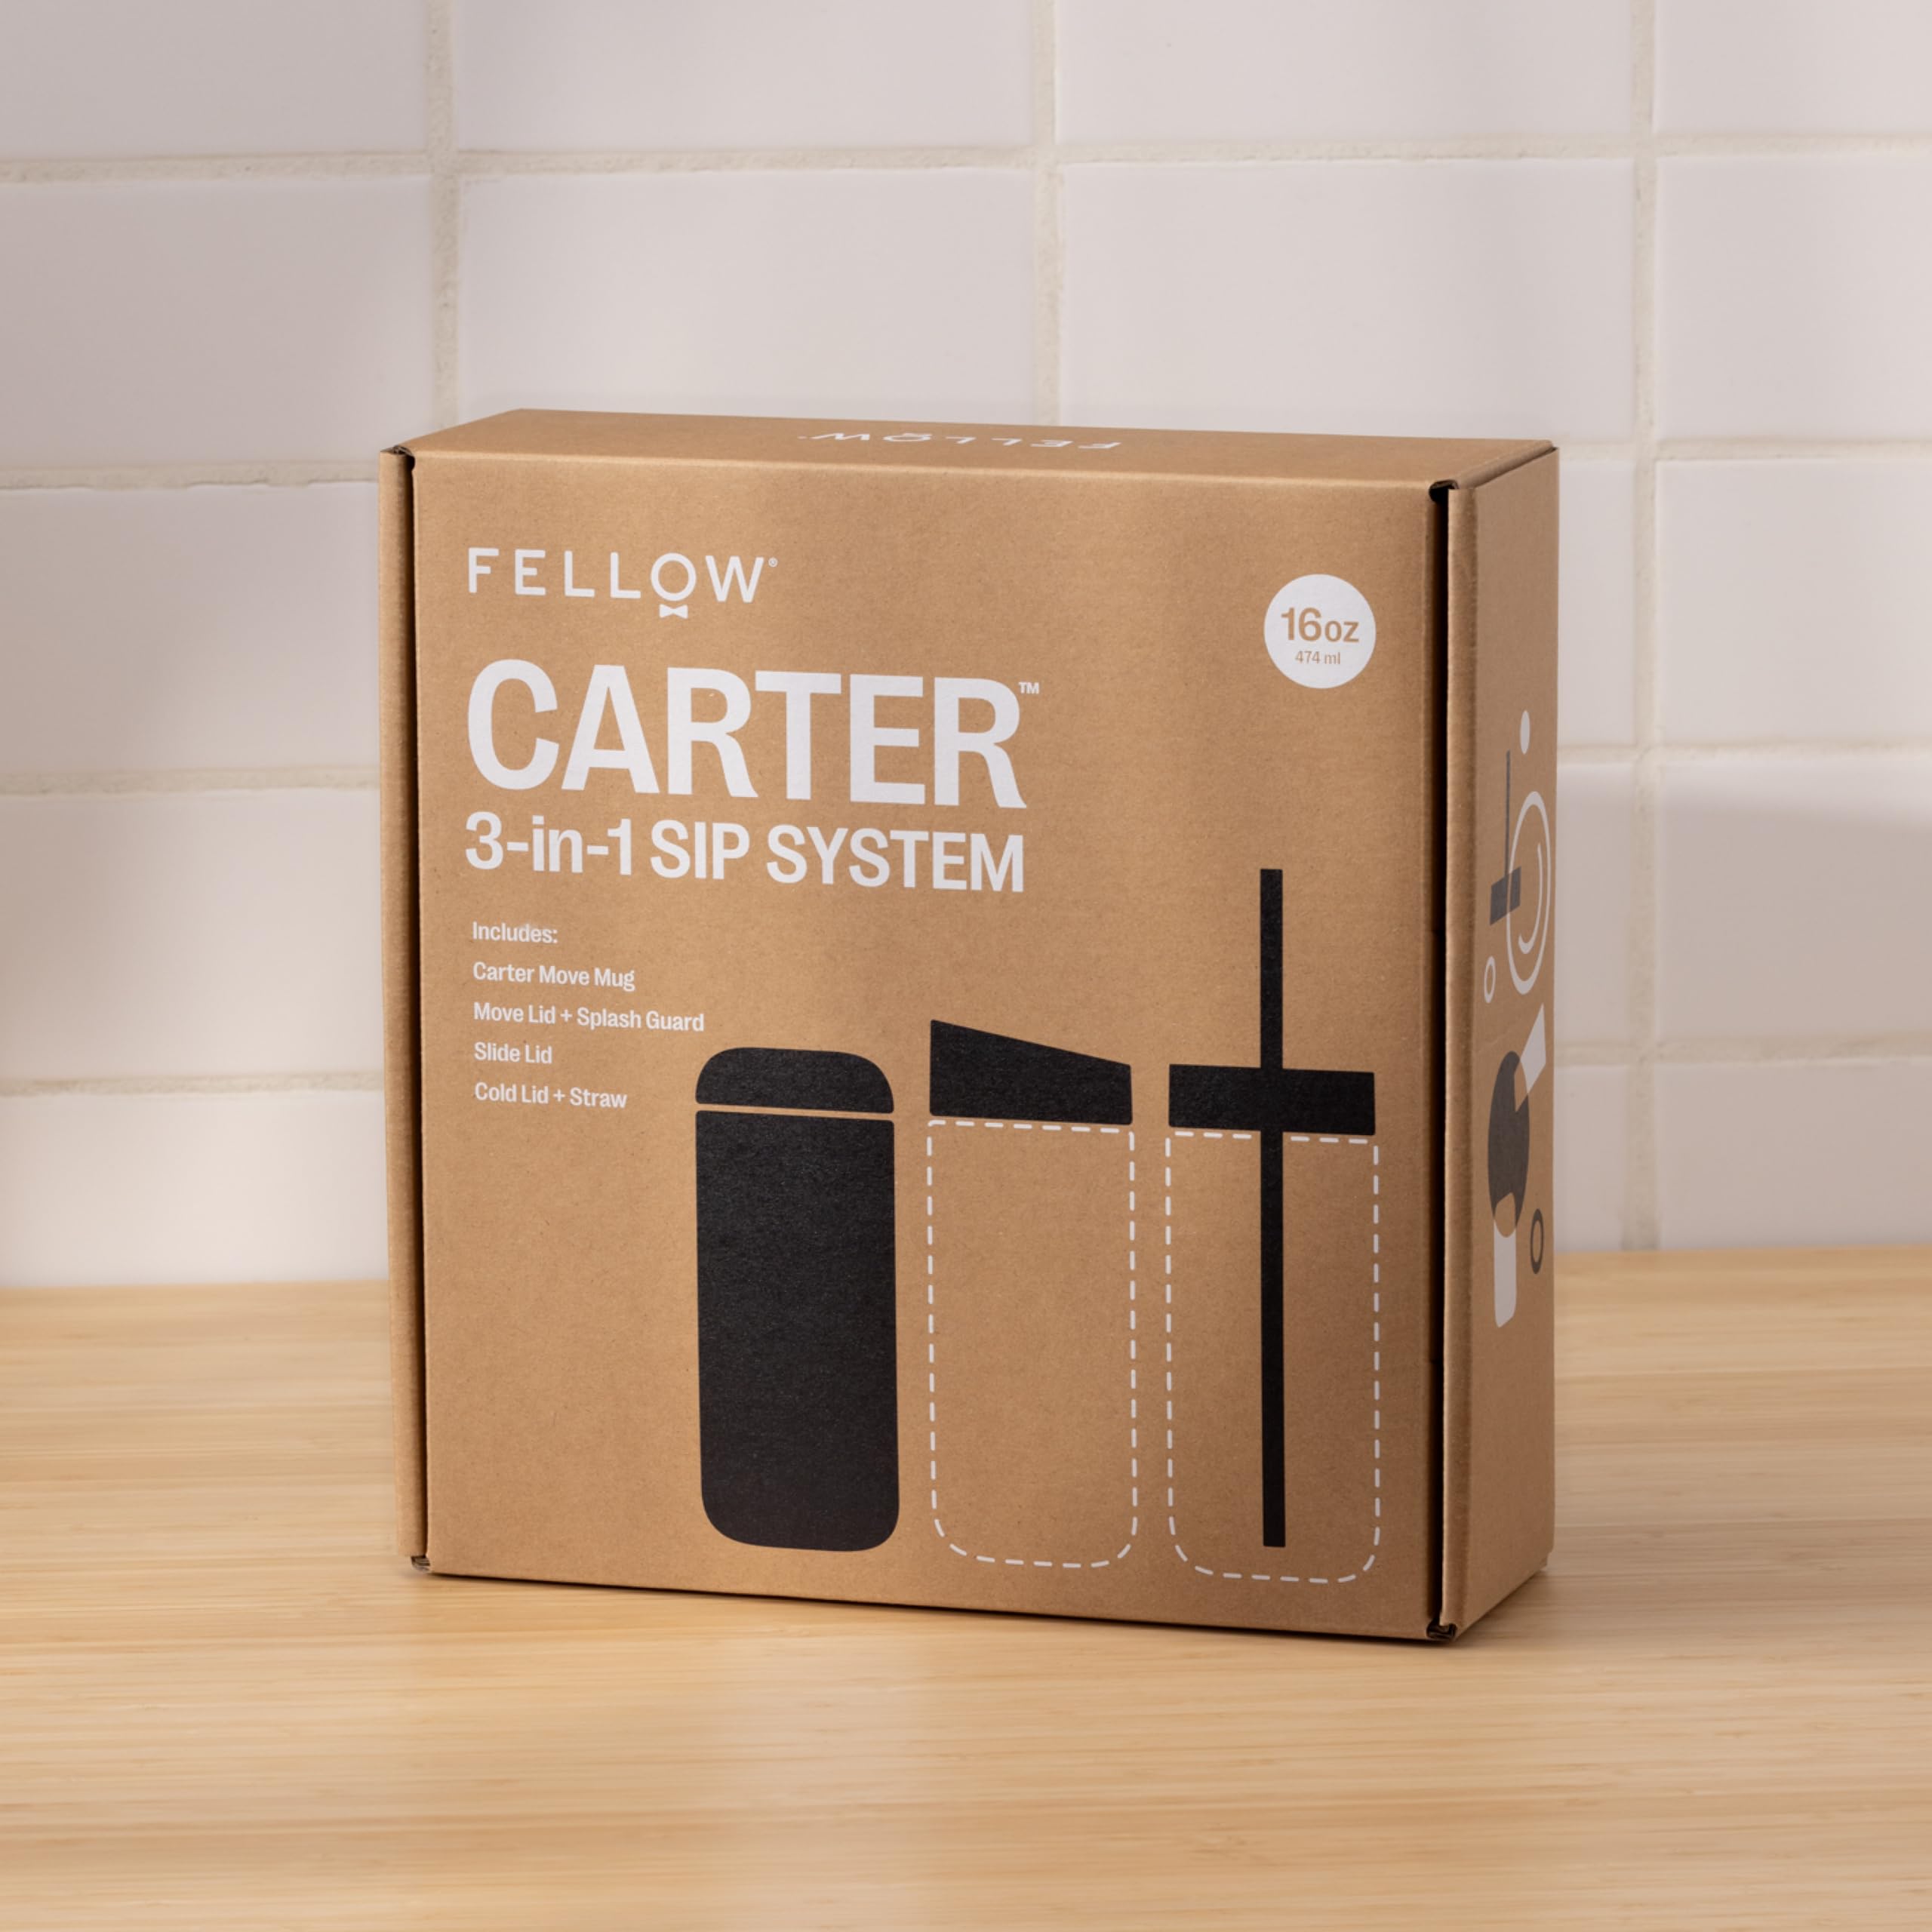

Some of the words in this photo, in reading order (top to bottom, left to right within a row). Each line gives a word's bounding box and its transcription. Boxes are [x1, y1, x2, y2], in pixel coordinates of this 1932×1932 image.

[1281, 607, 1360, 643] 16oz
[1295, 650, 1321, 665] 474
[1324, 651, 1341, 666] ml
[465, 811, 632, 875] 3-in-1
[650, 820, 750, 881] SIP
[767, 824, 1024, 893] SYSTEM
[472, 921, 558, 944] Includes:
[472, 961, 534, 983] Carter
[539, 964, 589, 986] Move
[594, 968, 635, 992] Mug
[473, 1001, 524, 1023] Move
[528, 1004, 556, 1024] Lid
[560, 1009, 572, 1023] +
[577, 1007, 641, 1030] Splash
[645, 1011, 705, 1032] Guard
[474, 1041, 520, 1063] Slide
[525, 1044, 552, 1065] Lid
[475, 1081, 517, 1103] Cold
[521, 1084, 549, 1105] Lid
[553, 1089, 565, 1103] +
[570, 1087, 628, 1109] Straw
